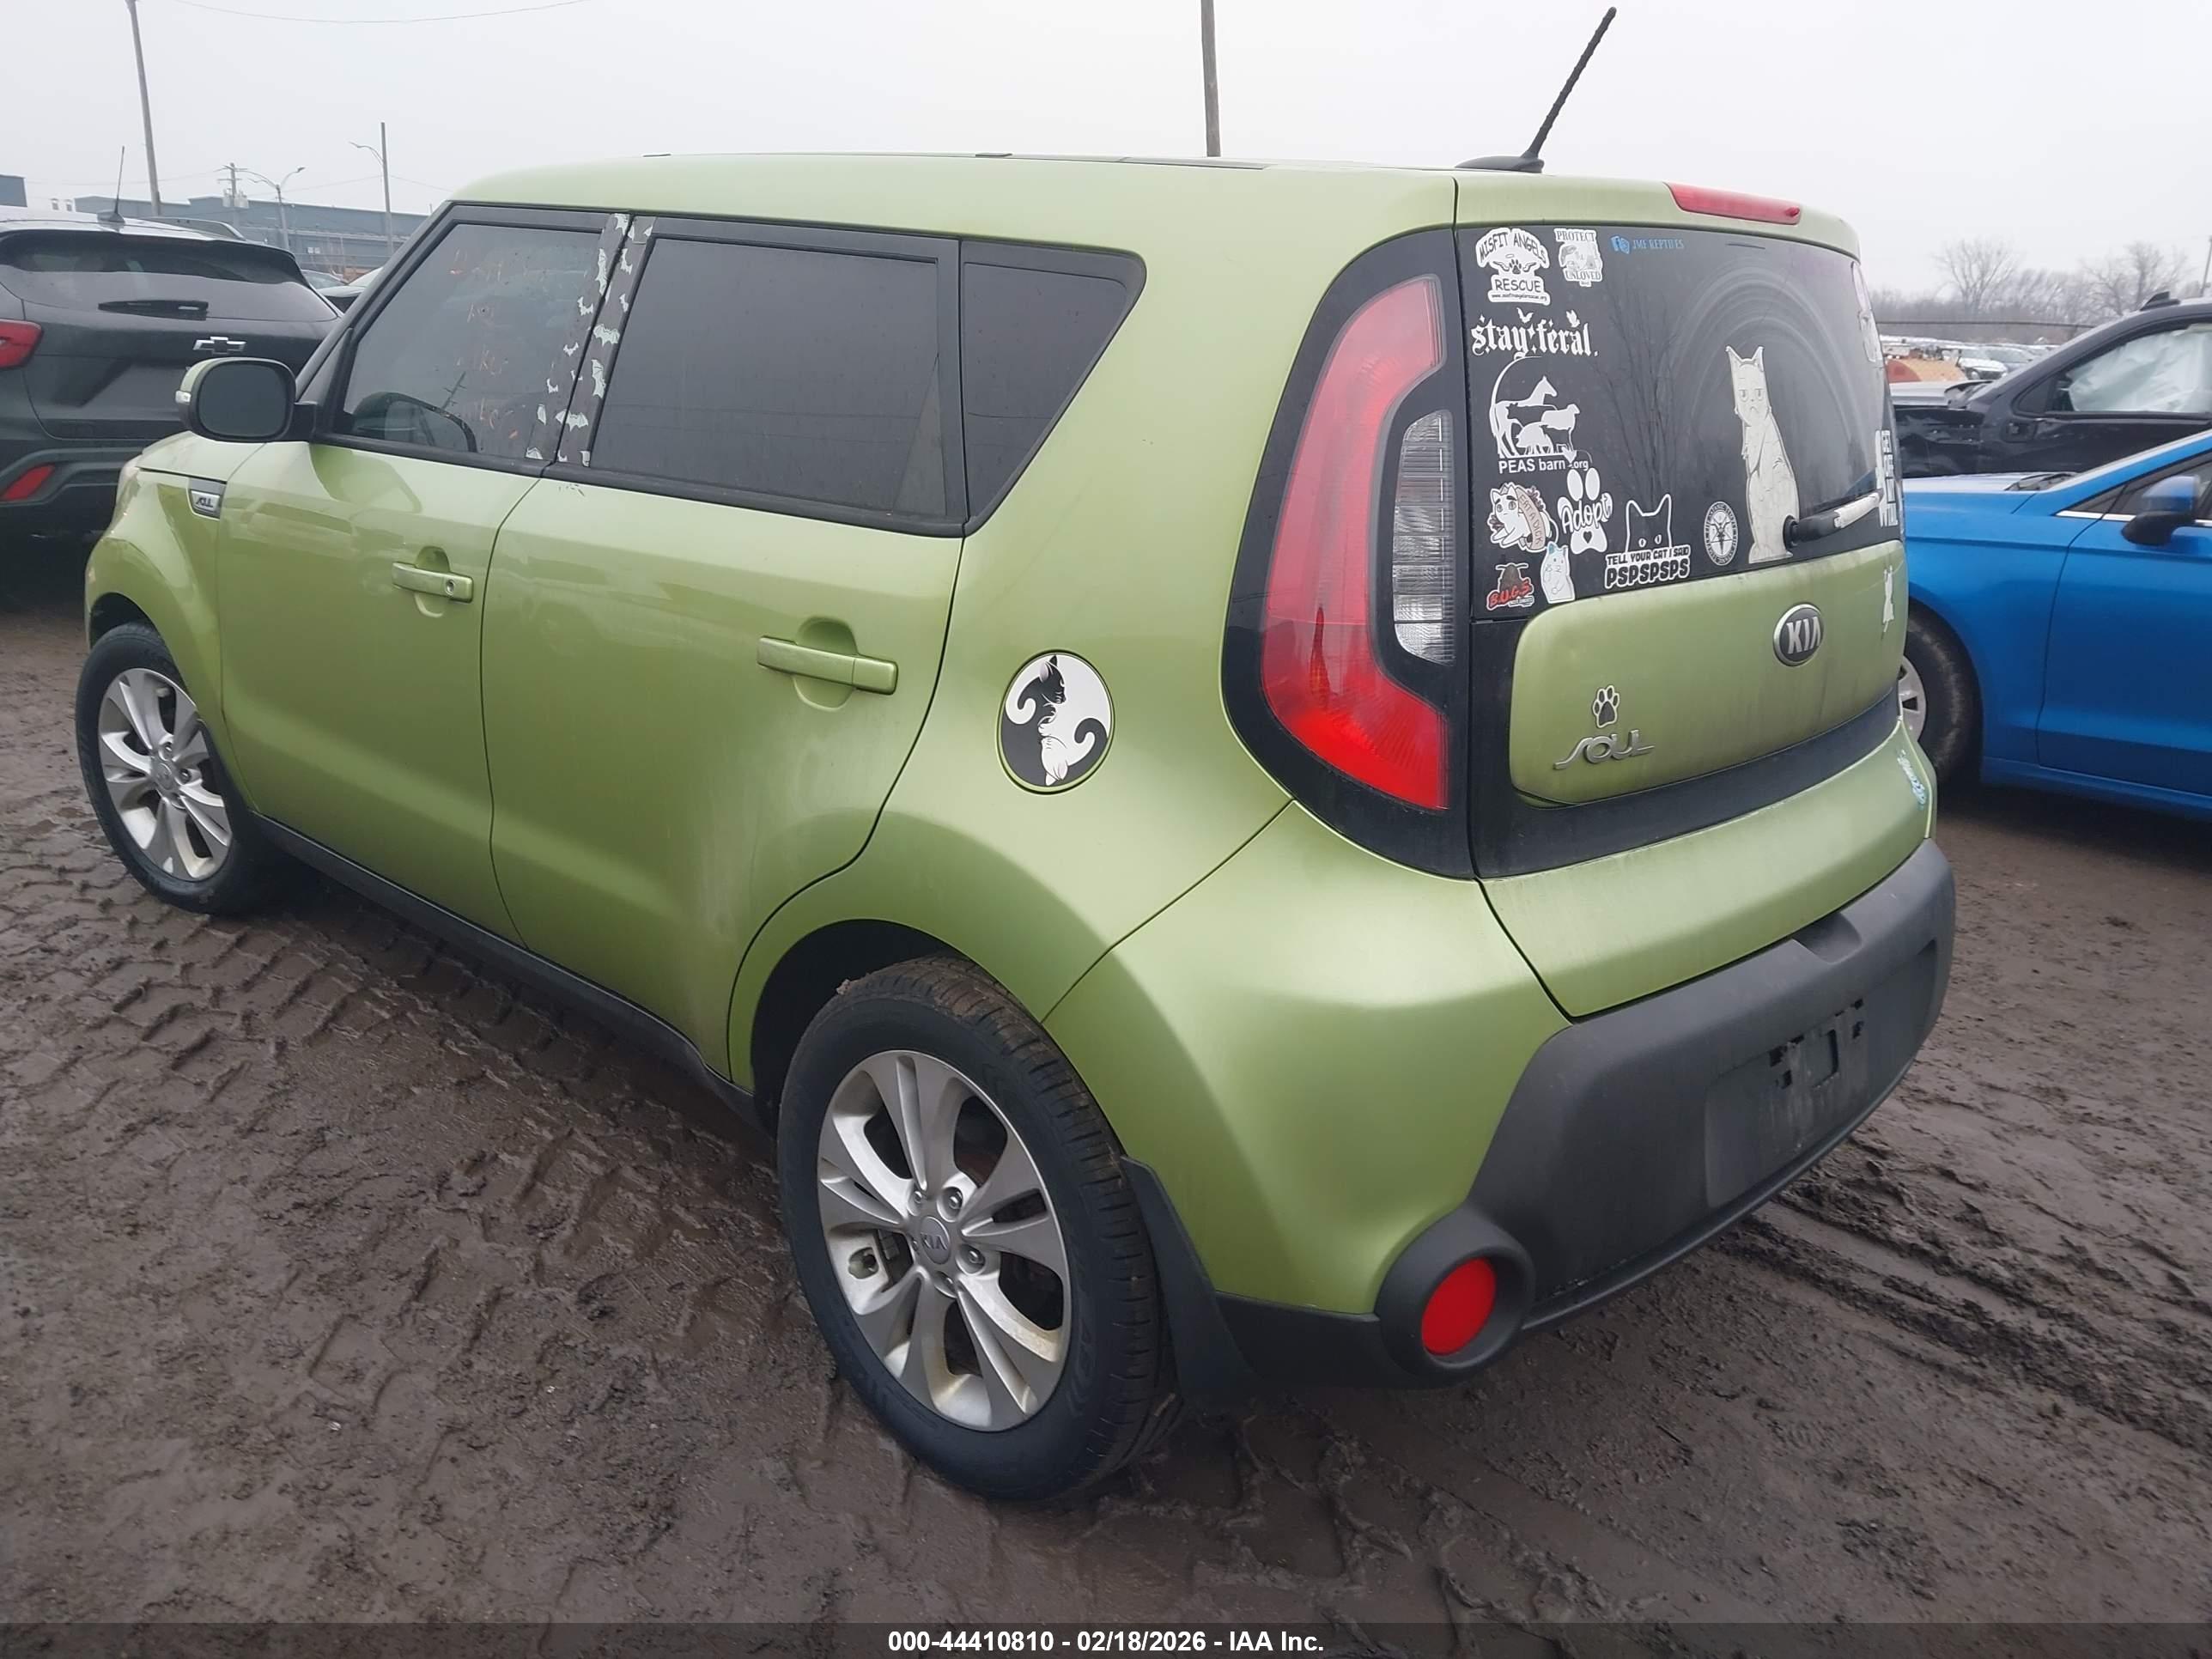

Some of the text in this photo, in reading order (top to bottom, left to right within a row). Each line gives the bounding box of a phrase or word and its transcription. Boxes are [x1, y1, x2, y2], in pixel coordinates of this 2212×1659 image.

[1479, 231, 1547, 264] MISFIT ANGELS
[1556, 230, 1595, 242] PROTECT
[1494, 277, 1541, 293] RESCUE
[1565, 270, 1601, 281] UNLOVED
[1470, 318, 1529, 361] stay
[1498, 458, 1535, 474] PEAS
[1538, 458, 1566, 471] barn
[1519, 494, 1534, 511] EAT
[1532, 520, 1543, 544] DICK
[1561, 493, 1611, 534] Adopt
[1606, 558, 1689, 587] PSPSPSPS
[1607, 554, 1628, 566] TELL
[1630, 550, 1651, 562] YOUR
[1653, 549, 1668, 560] CAT
[1786, 616, 1821, 654] KIA
[1553, 729, 1655, 769] SOUL
